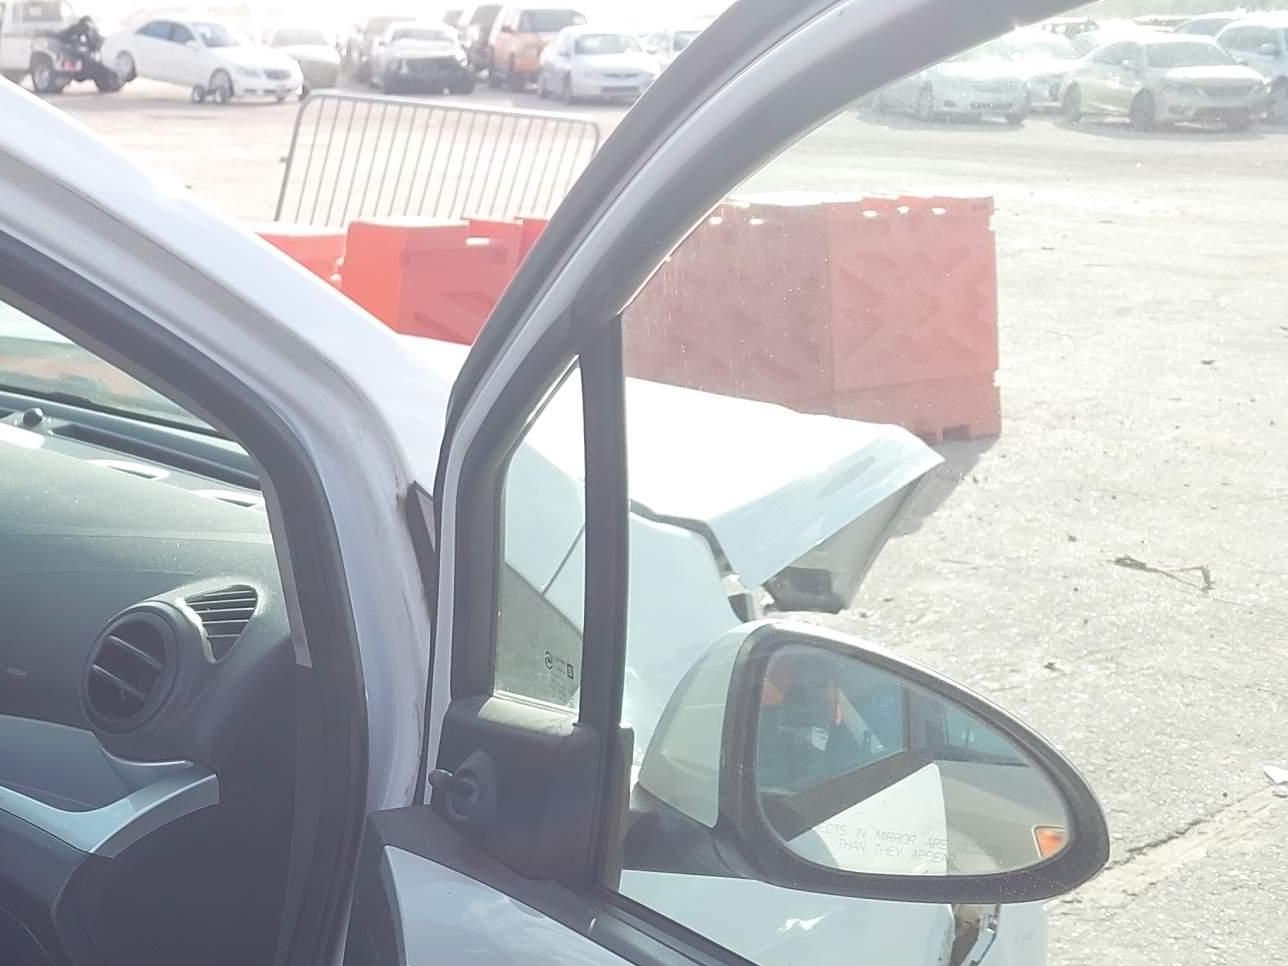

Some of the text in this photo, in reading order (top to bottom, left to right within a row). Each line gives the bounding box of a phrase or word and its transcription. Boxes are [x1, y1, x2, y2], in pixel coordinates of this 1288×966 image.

[839, 838, 957, 864] THAN THEY APPEAR
[875, 829, 917, 845] MIRROR
[926, 837, 949, 850] ARE
